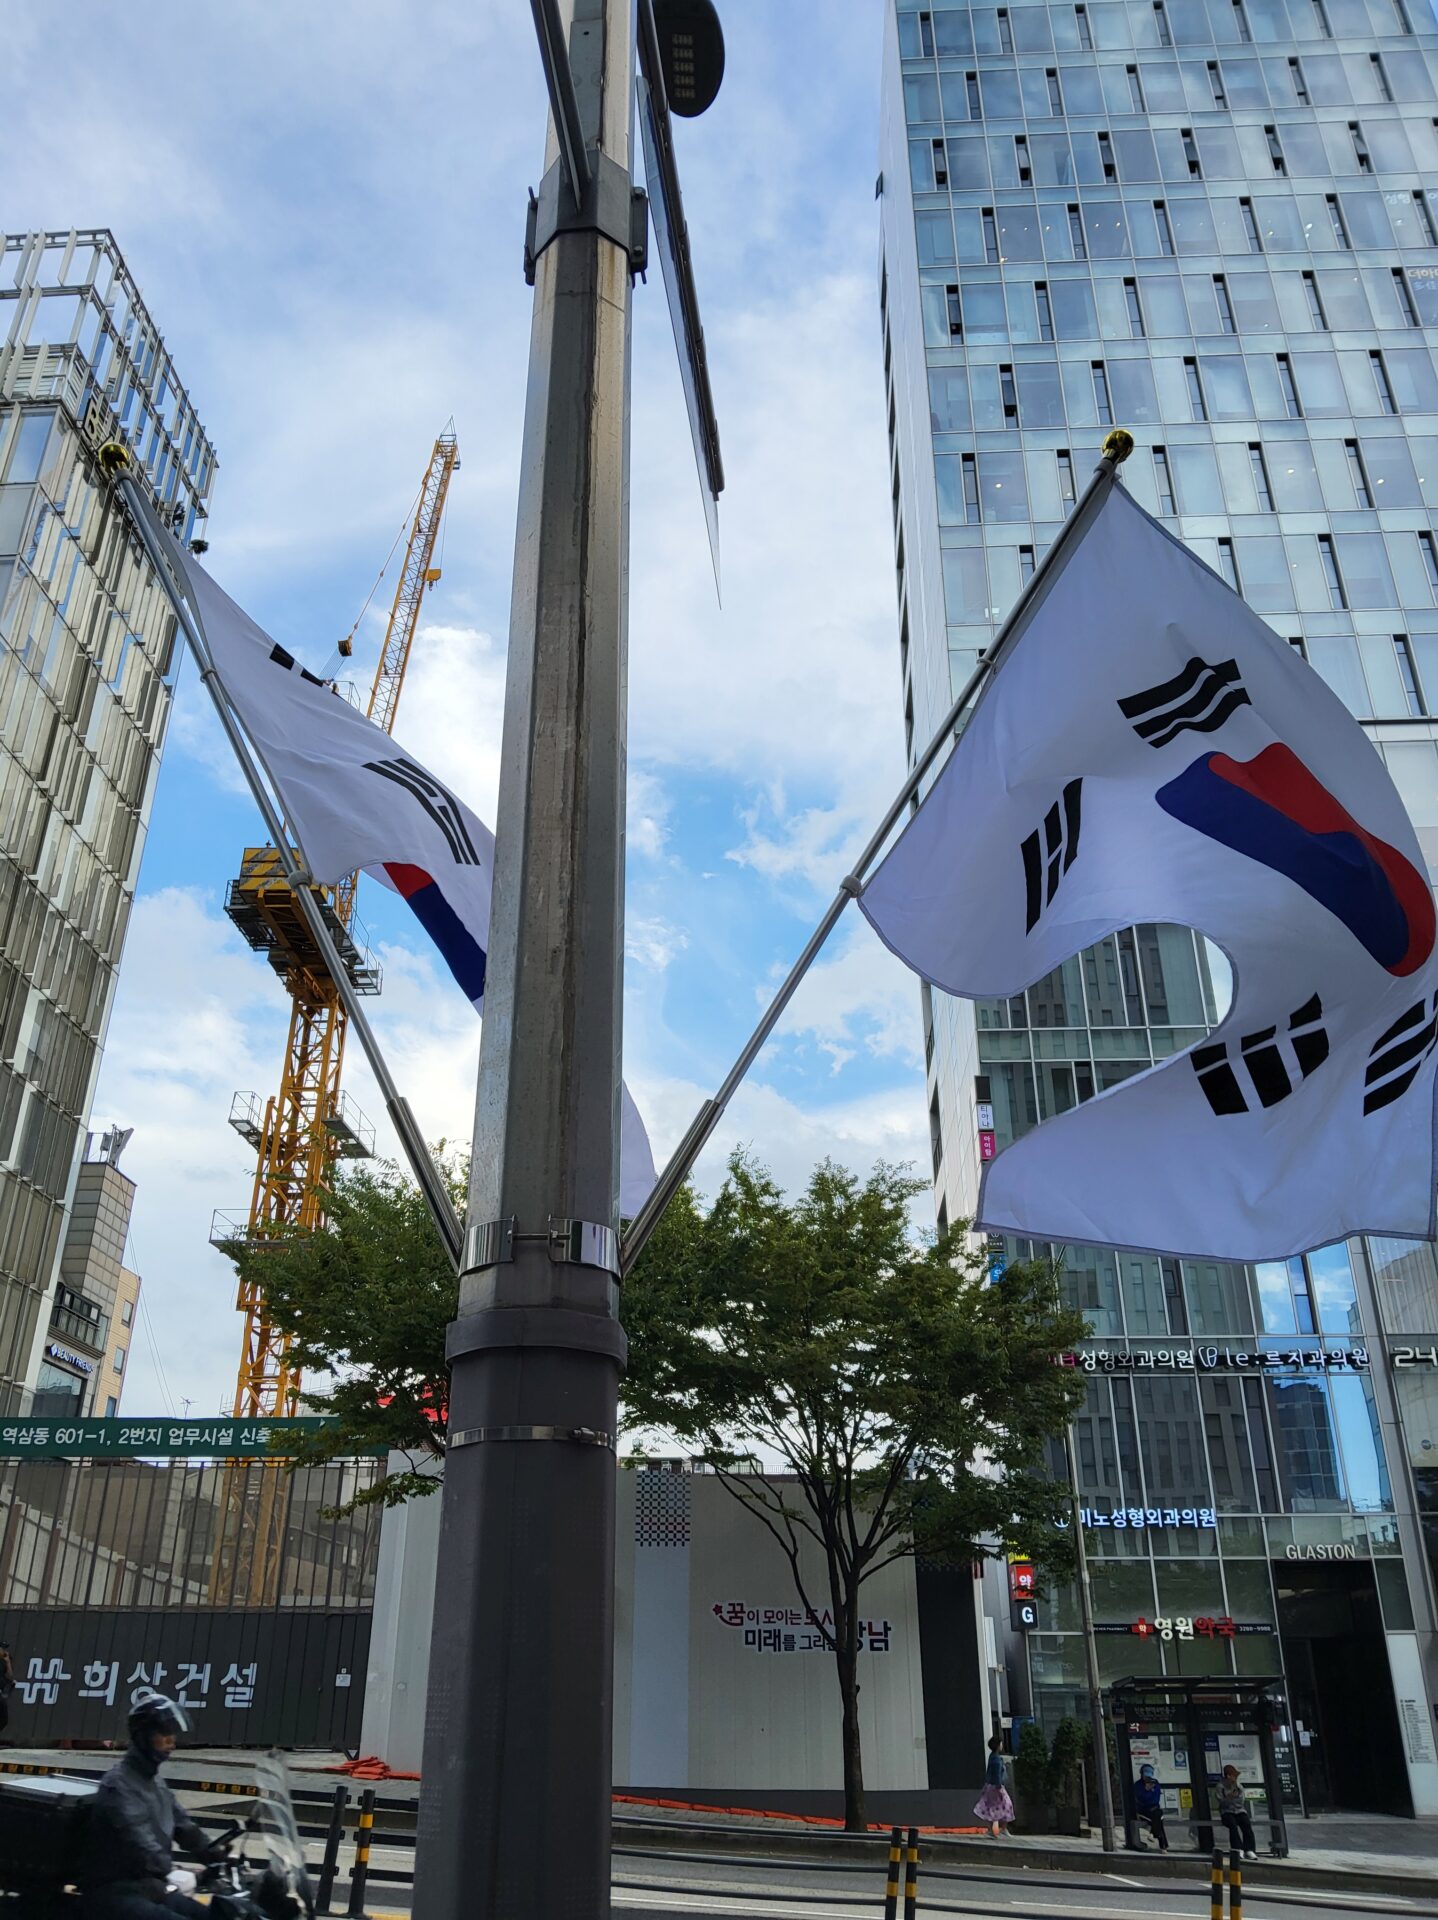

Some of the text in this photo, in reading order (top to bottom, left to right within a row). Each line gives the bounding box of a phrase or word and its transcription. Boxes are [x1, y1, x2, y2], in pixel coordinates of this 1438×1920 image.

[2, 1427, 50, 1445] 역삼동
[55, 1428, 111, 1446] 601-1,
[118, 1427, 162, 1445] 2번지
[168, 1427, 234, 1446] 업무시설
[1286, 1544, 1356, 1560] GLASTON
[726, 1602, 760, 1627] 꿈이
[762, 1609, 801, 1626] 모이는
[1021, 1606, 1034, 1624] G
[744, 1628, 796, 1652] 미래를
[77, 1660, 258, 1708] 희상건설
